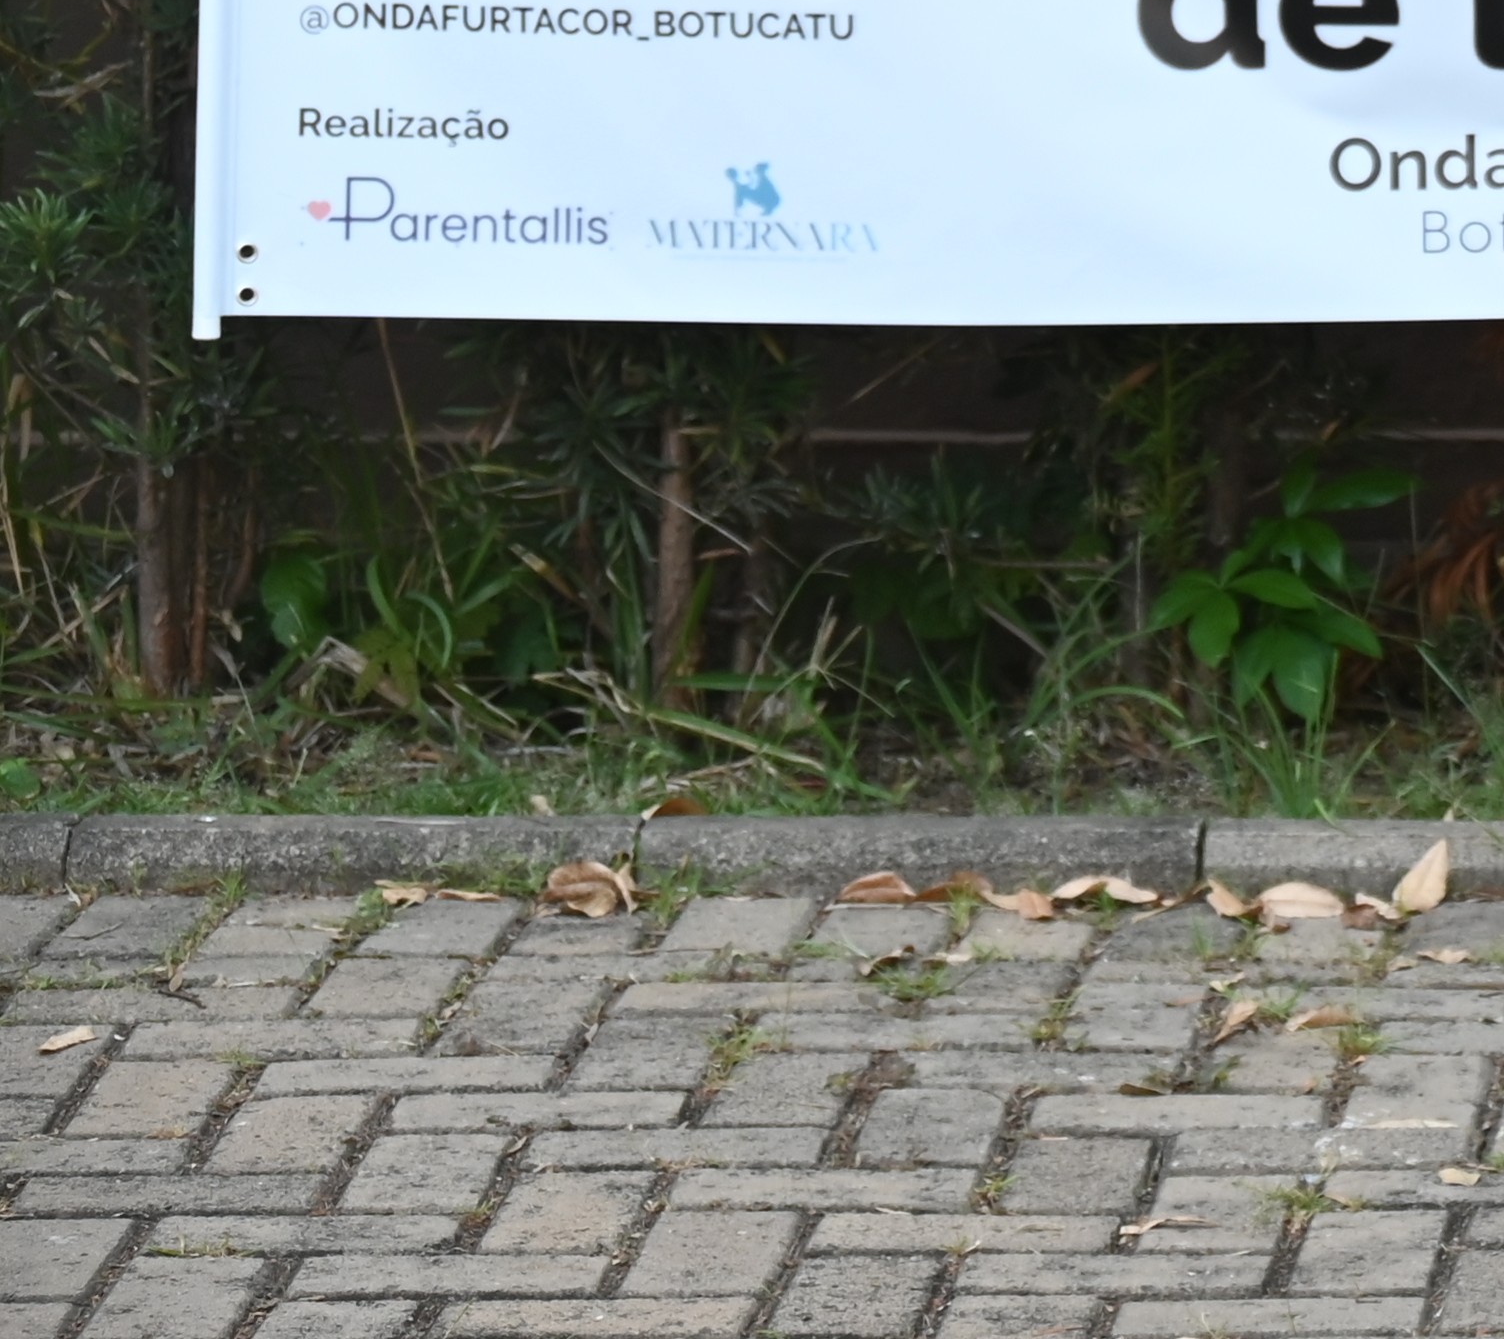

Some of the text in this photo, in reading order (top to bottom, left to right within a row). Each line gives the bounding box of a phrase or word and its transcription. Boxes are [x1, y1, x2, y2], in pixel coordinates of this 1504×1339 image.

[300, 2, 855, 41] @ONDAFURTACOR_BOTUCATU
[298, 108, 510, 146] Realização
[328, 176, 609, 245] Parentallis
